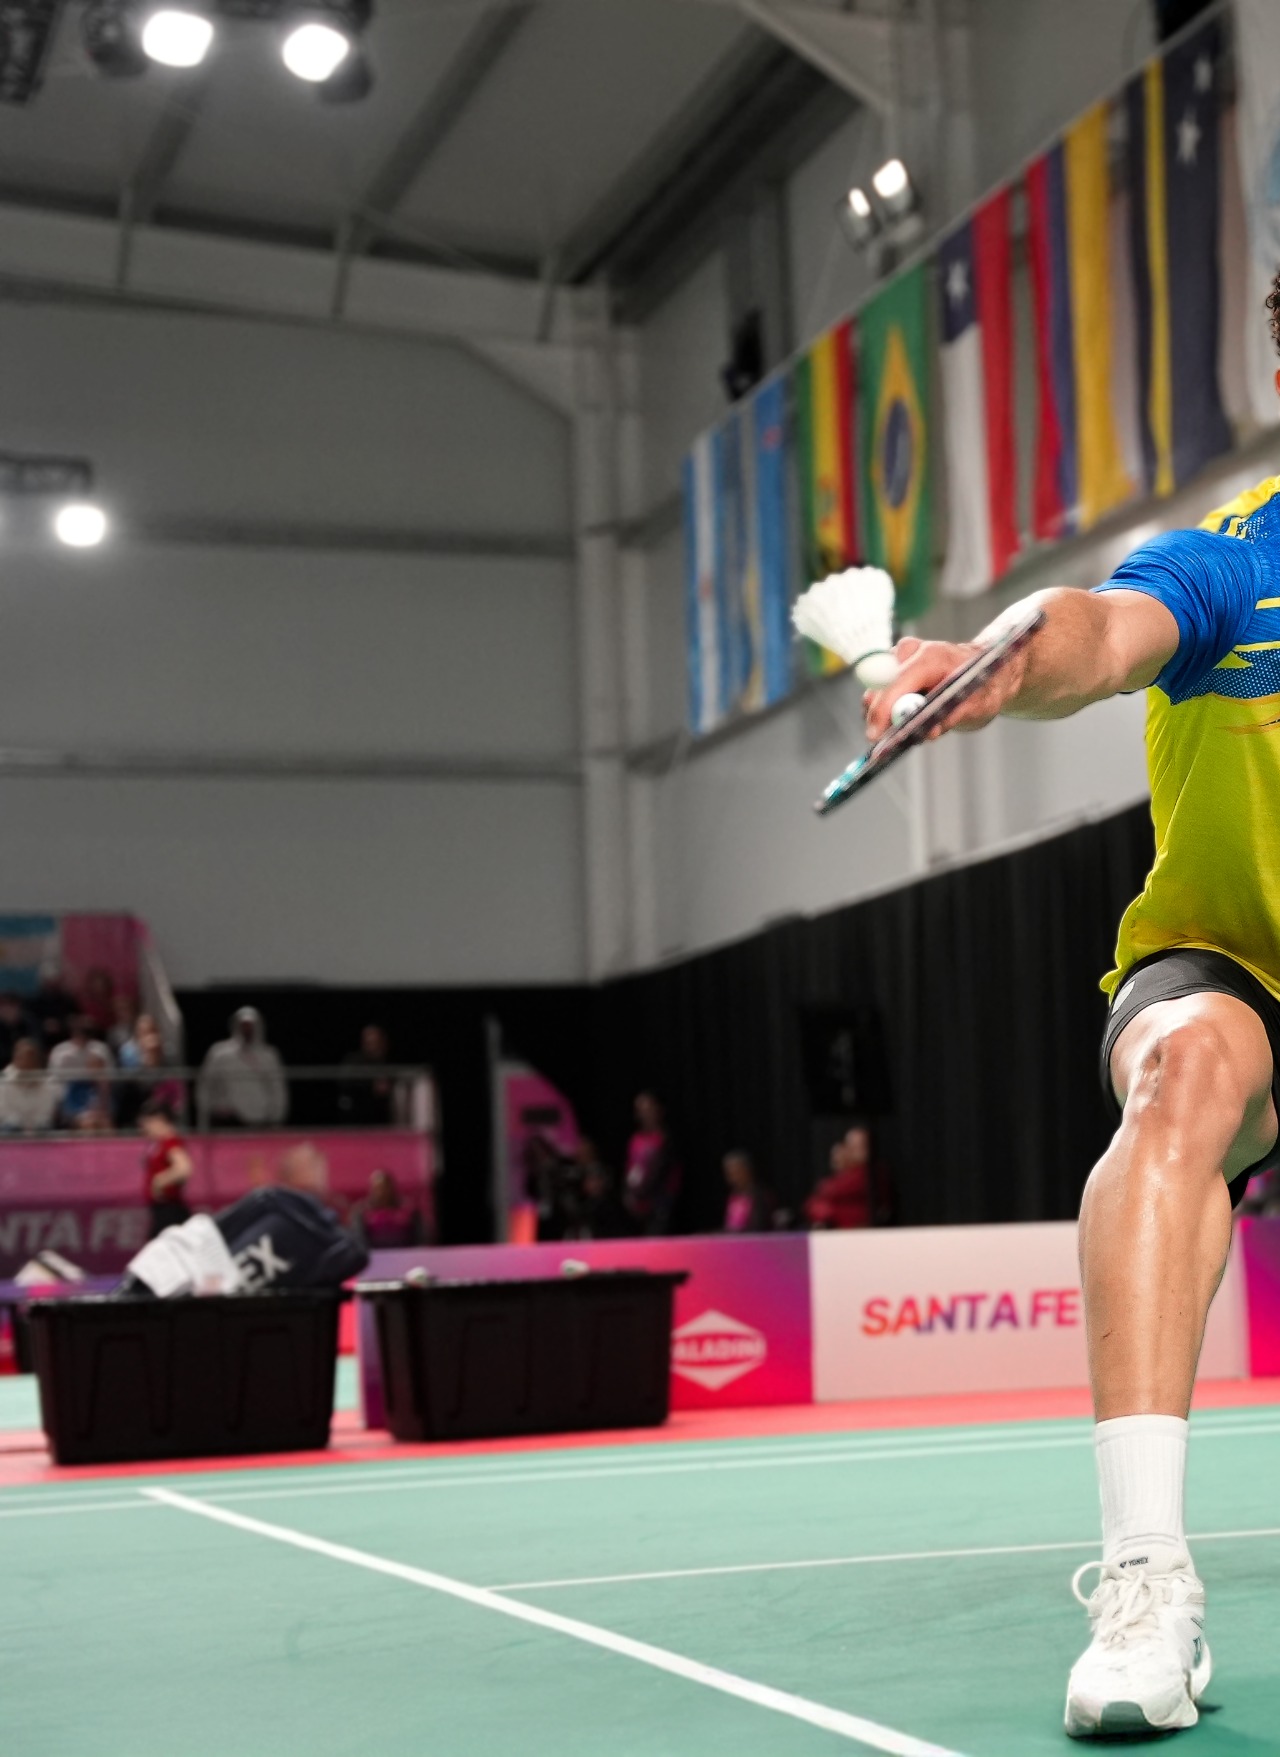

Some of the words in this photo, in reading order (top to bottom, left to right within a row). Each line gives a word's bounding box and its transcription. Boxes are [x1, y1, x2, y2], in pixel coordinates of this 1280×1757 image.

[861, 1293, 1020, 1337] SANTA
[1030, 1289, 1079, 1327] FE
[1129, 1557, 1149, 1566] YONEX
